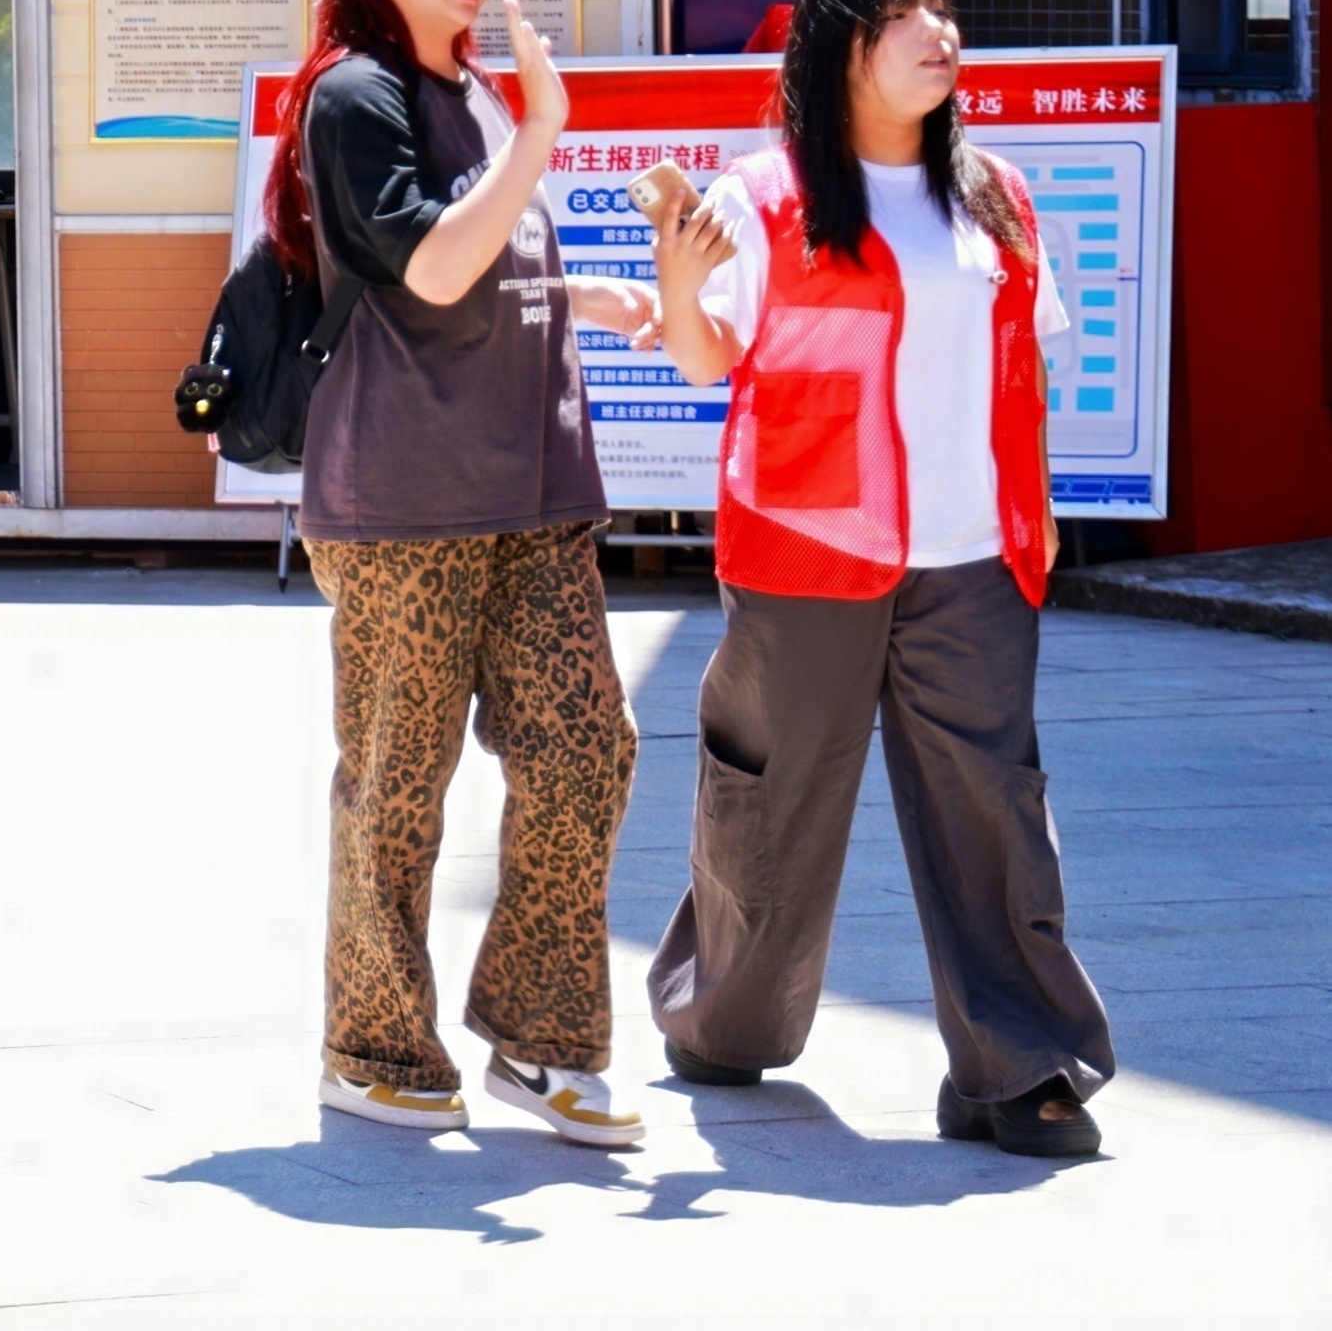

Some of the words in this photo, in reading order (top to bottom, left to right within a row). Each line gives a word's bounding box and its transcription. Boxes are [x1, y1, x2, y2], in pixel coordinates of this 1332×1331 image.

[1032, 87, 1146, 115] 智胜未来
[549, 144, 720, 171] 新生报到流程
[601, 405, 697, 420] 班主任安排宿舍
